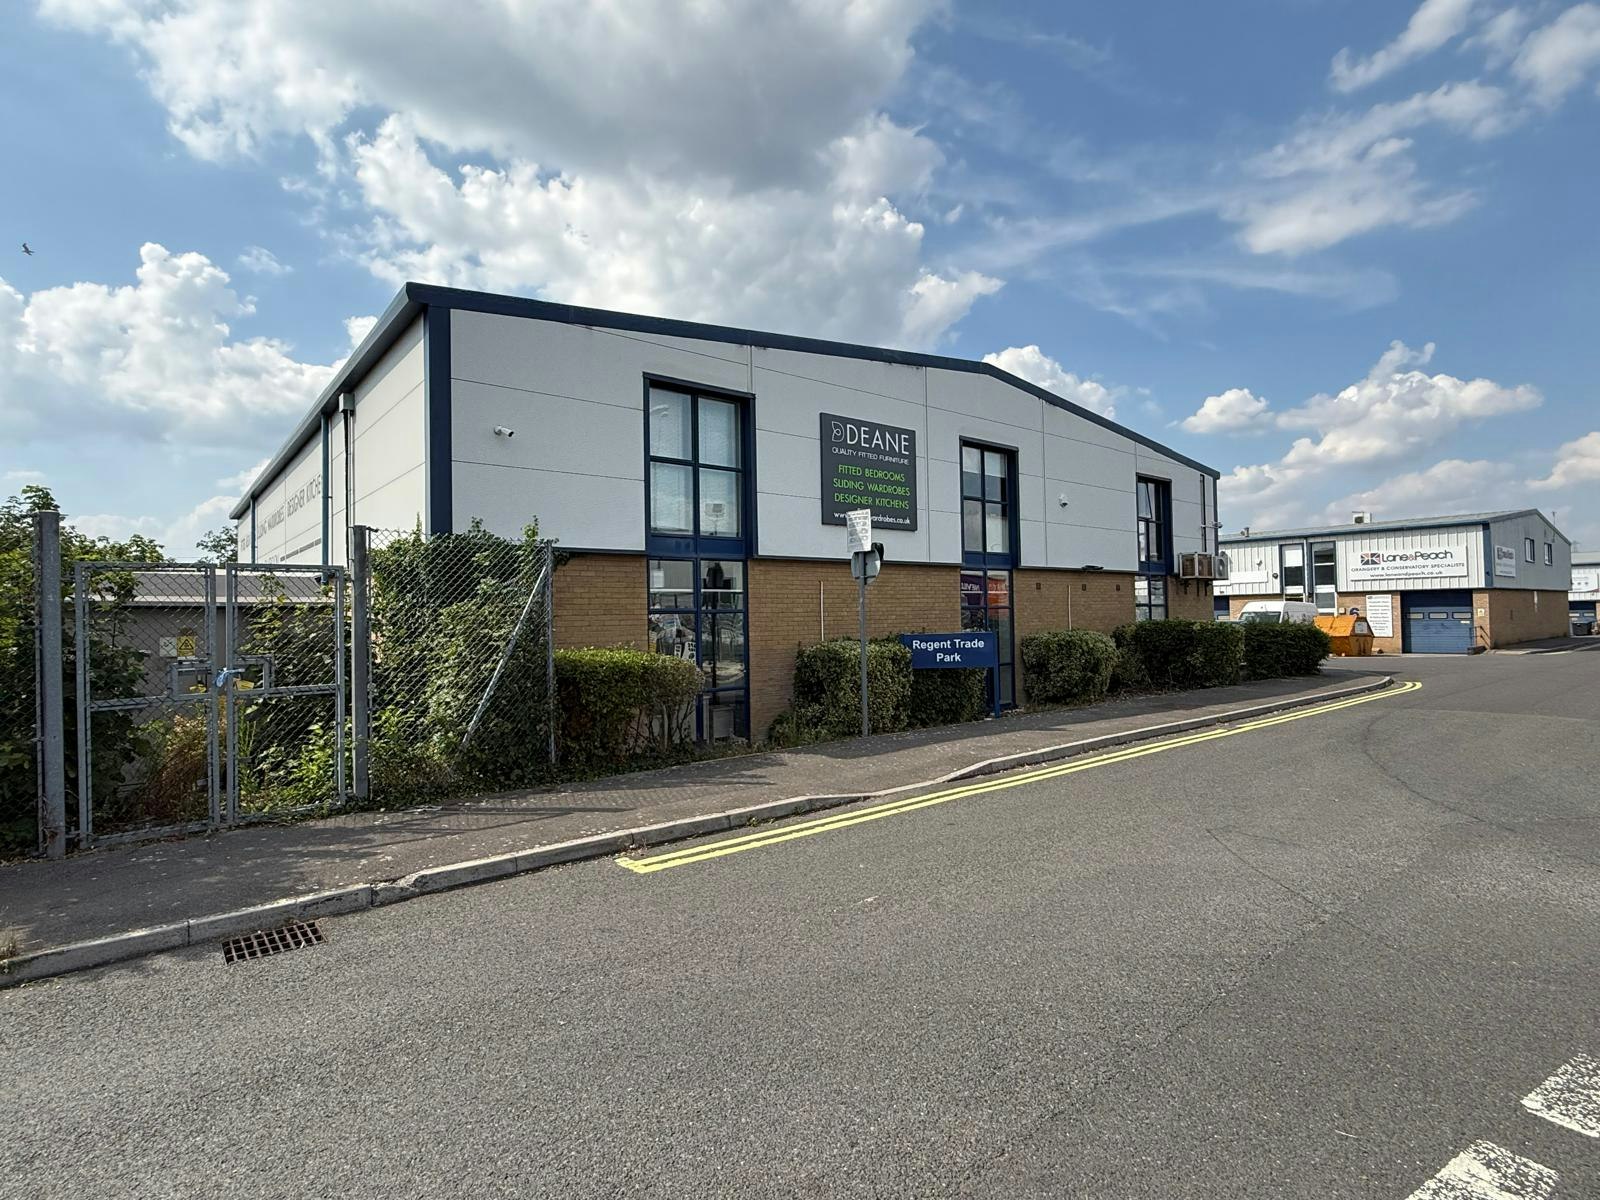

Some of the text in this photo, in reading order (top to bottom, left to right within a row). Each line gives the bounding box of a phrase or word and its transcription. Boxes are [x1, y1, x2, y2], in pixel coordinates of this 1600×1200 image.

[846, 424, 910, 455] DEANE
[832, 446, 910, 466] QUALITY FITTED FURNITURE
[838, 464, 906, 482] FITTED BEDROOMS
[833, 478, 911, 497] SLIDING WARDROBES
[834, 492, 910, 510] DESIGNER KITCHENS
[912, 638, 985, 652] Regent Trade
[936, 652, 962, 663] Park
